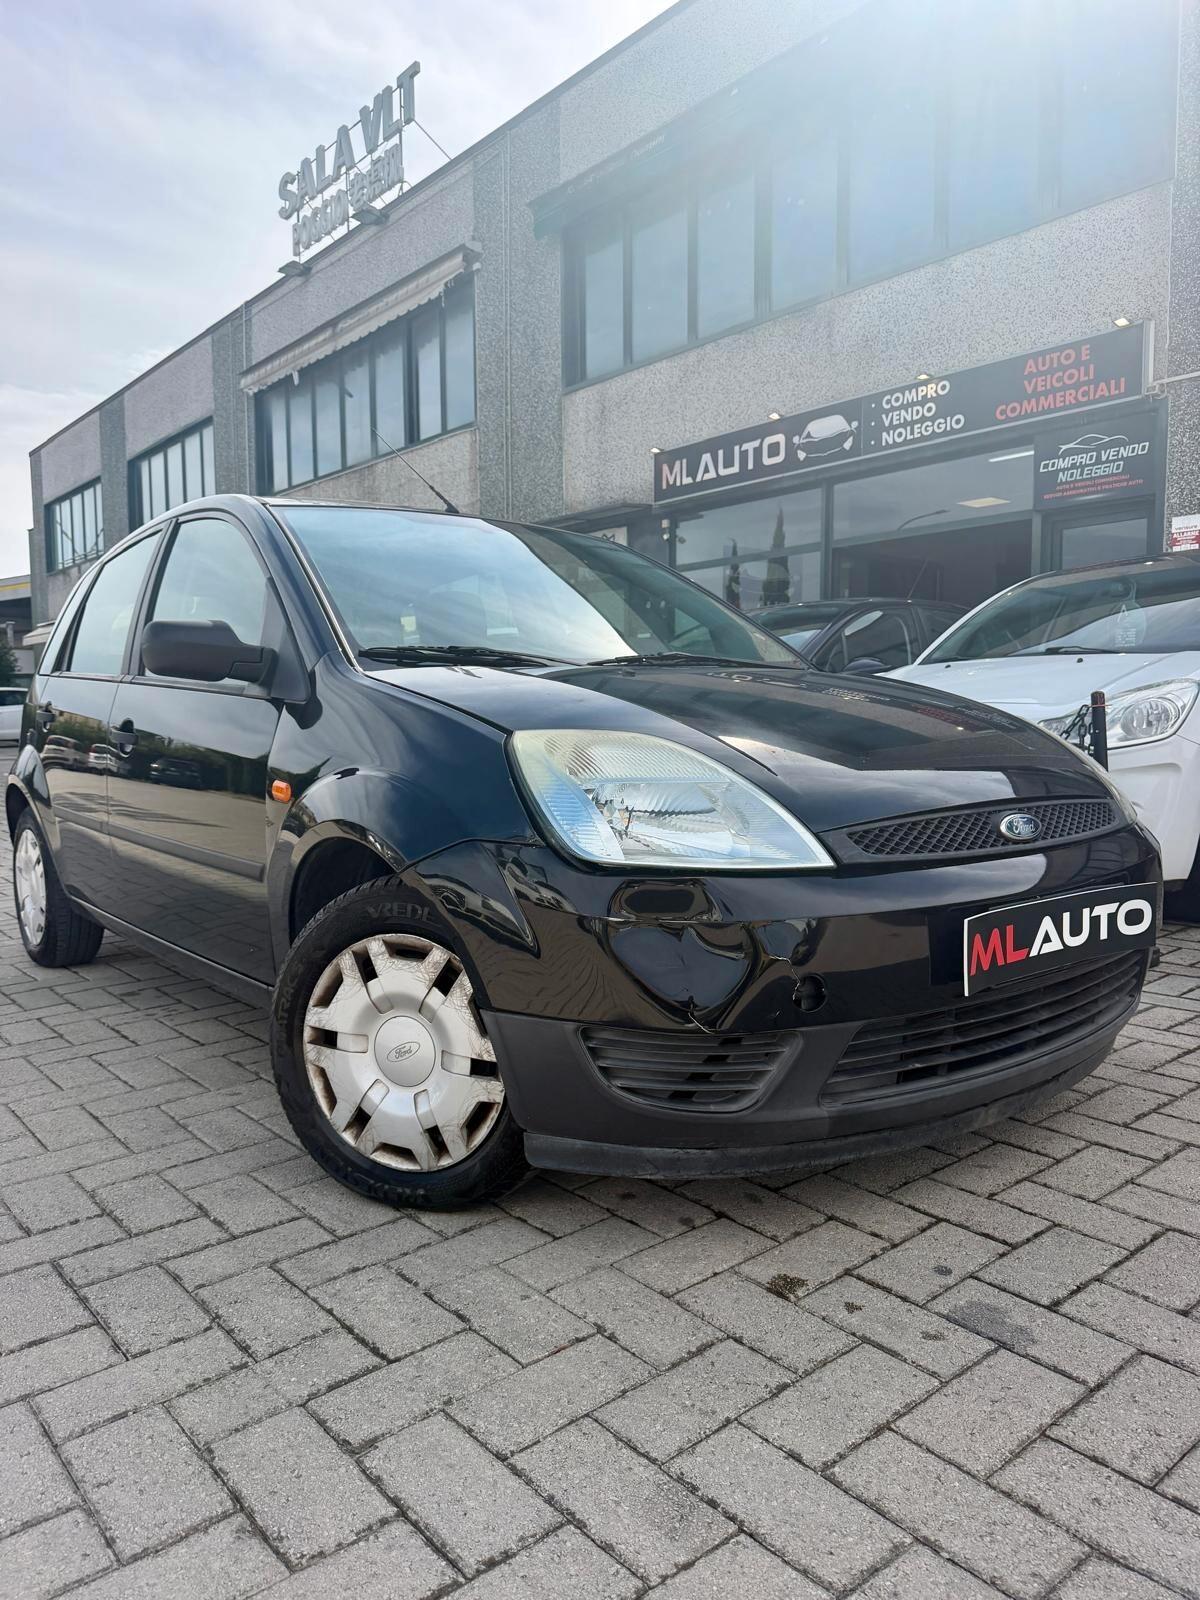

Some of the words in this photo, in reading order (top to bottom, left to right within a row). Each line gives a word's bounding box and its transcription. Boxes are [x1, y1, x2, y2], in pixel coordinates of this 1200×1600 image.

[278, 125, 355, 220] SALA
[359, 61, 420, 154] VLT
[1024, 349, 1076, 375] AUTO
[1081, 345, 1090, 360] E
[1024, 364, 1095, 394] VEICOLI
[882, 380, 950, 409] COMPRO
[995, 378, 1126, 420] COMMERCIALI
[882, 403, 936, 427] VENDO
[882, 414, 965, 446] NOLEGGIO
[662, 433, 786, 490] MLAUTO
[1040, 452, 1097, 472] COMPRO
[1101, 442, 1149, 461] VENDO
[1057, 461, 1124, 483] NOLEGGIO
[970, 899, 1152, 976] MLAUTO
